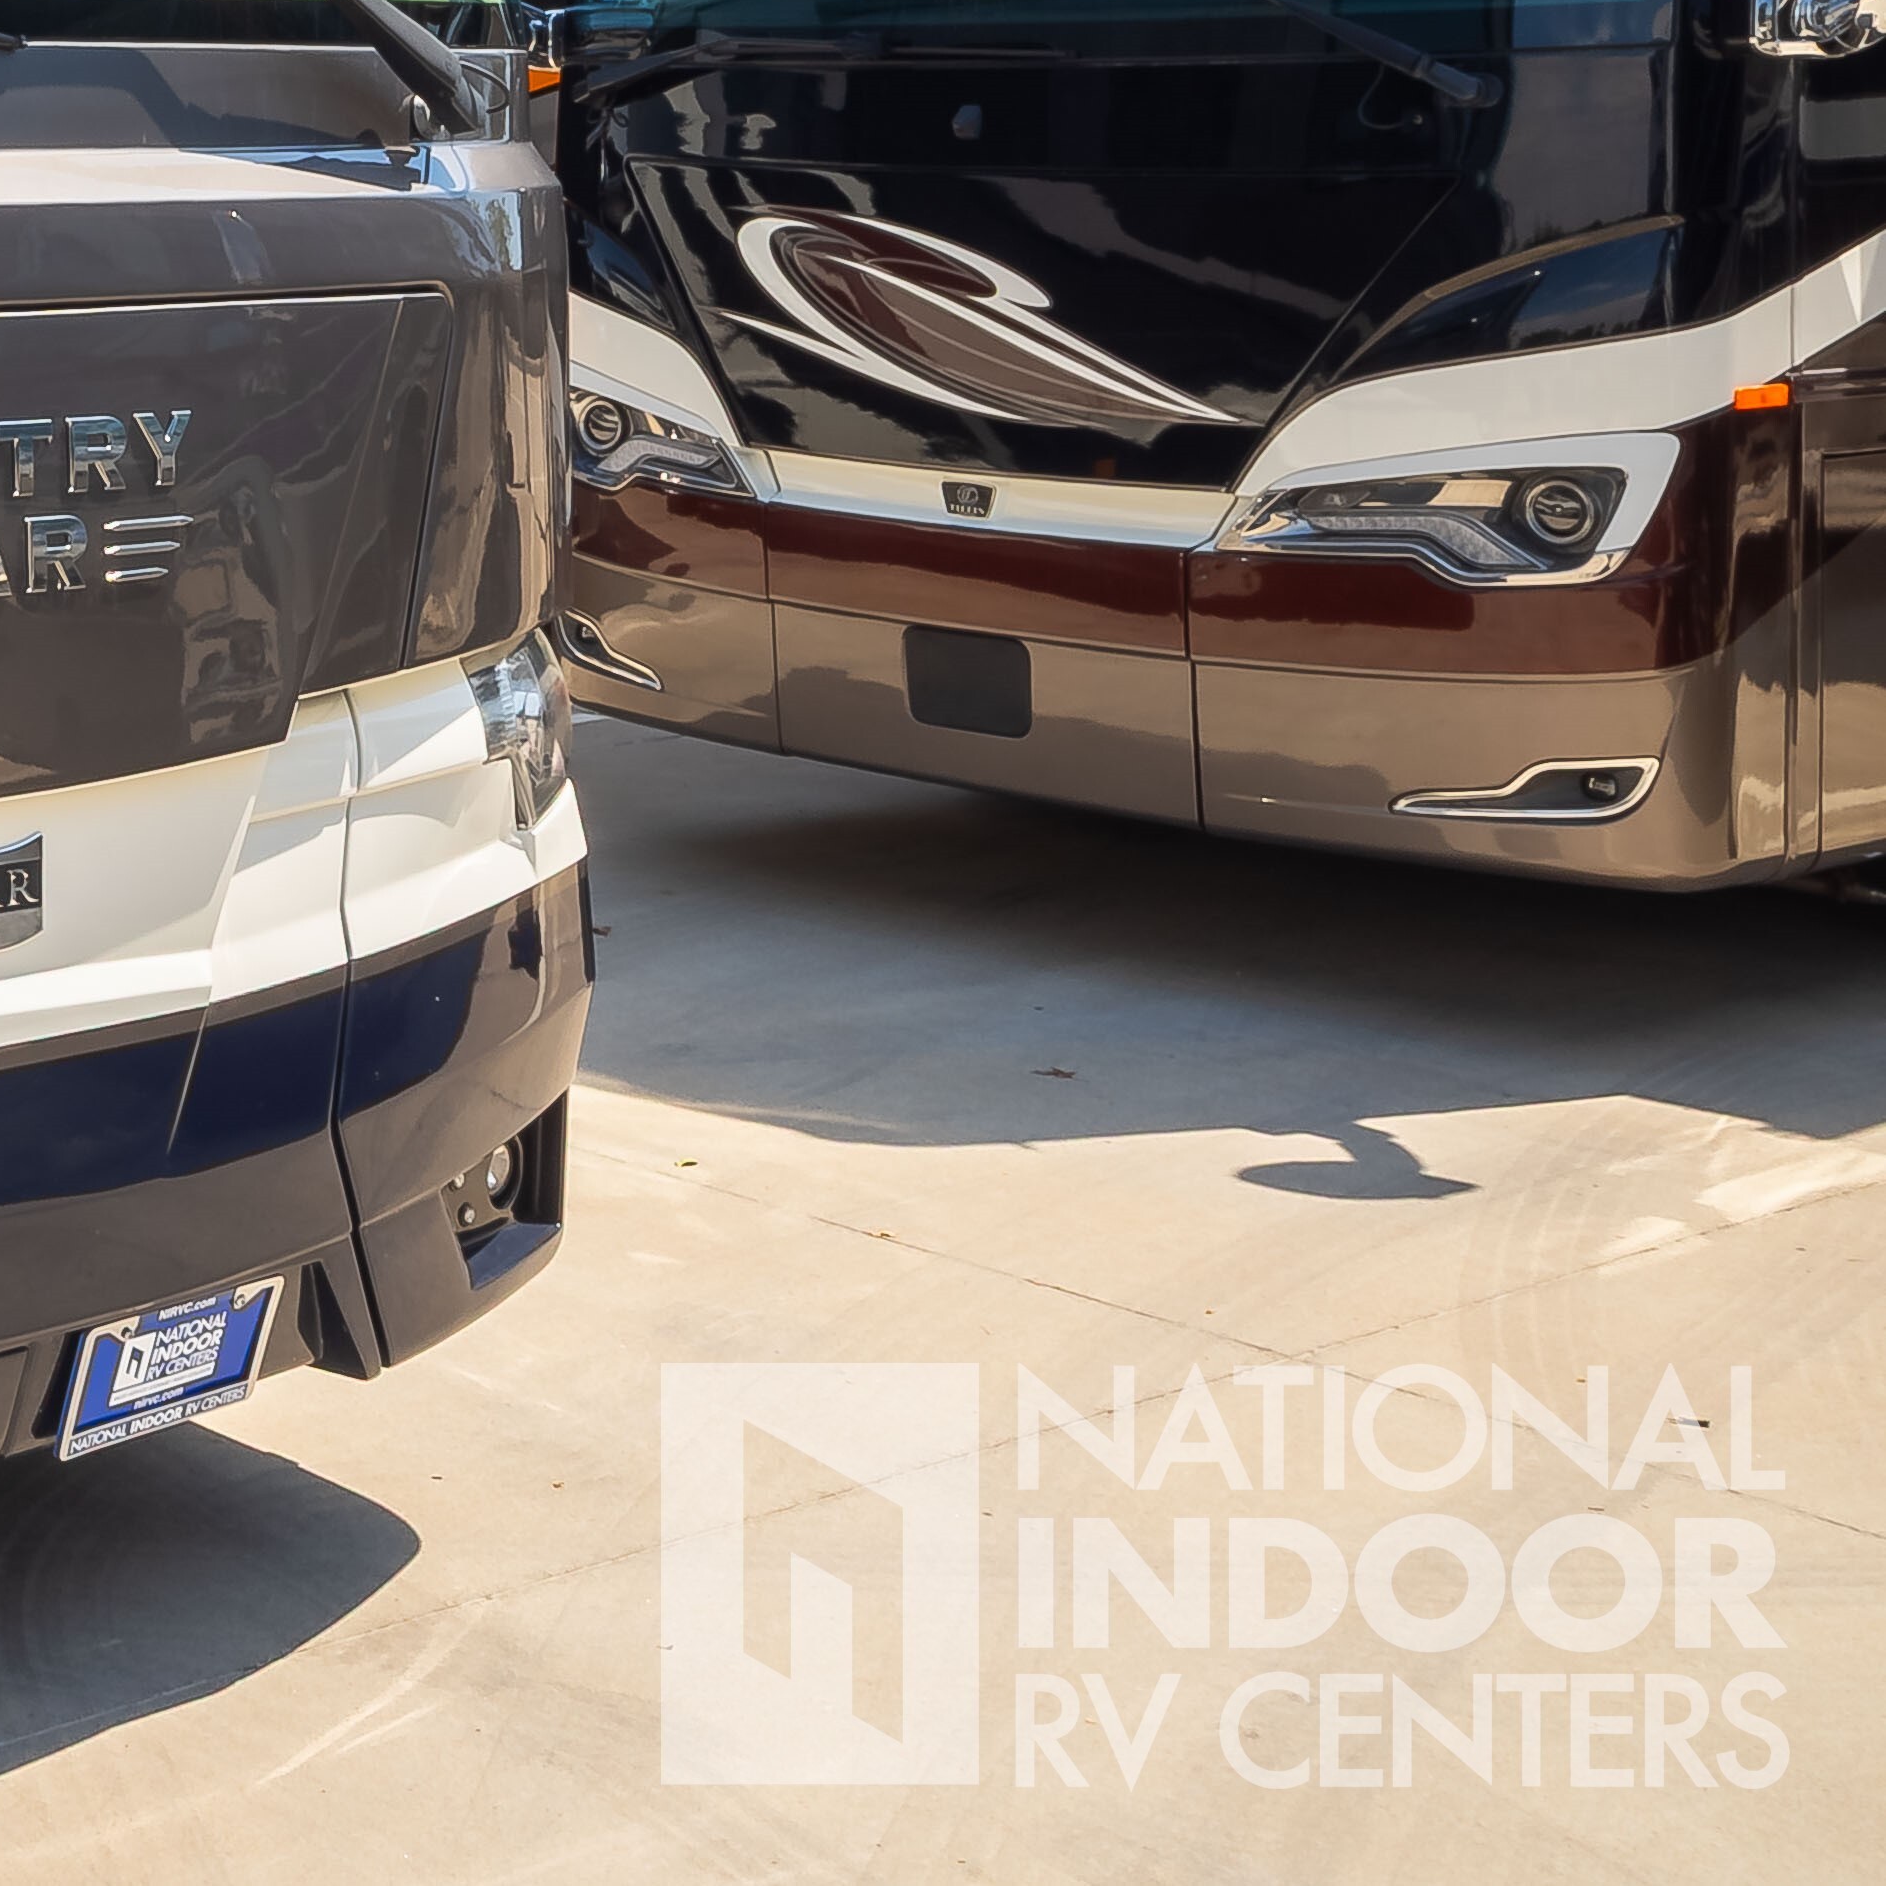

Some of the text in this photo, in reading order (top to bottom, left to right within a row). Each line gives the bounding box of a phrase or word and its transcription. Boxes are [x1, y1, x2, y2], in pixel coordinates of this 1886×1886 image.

[158, 1296, 217, 1322] NIRVC.com
[151, 1329, 223, 1364] INDOOR
[155, 1311, 227, 1347] NATIONAL
[146, 1346, 218, 1382] RV CENTERS
[69, 1385, 247, 1455] NATIONAL INDOOR RV CENTERS
